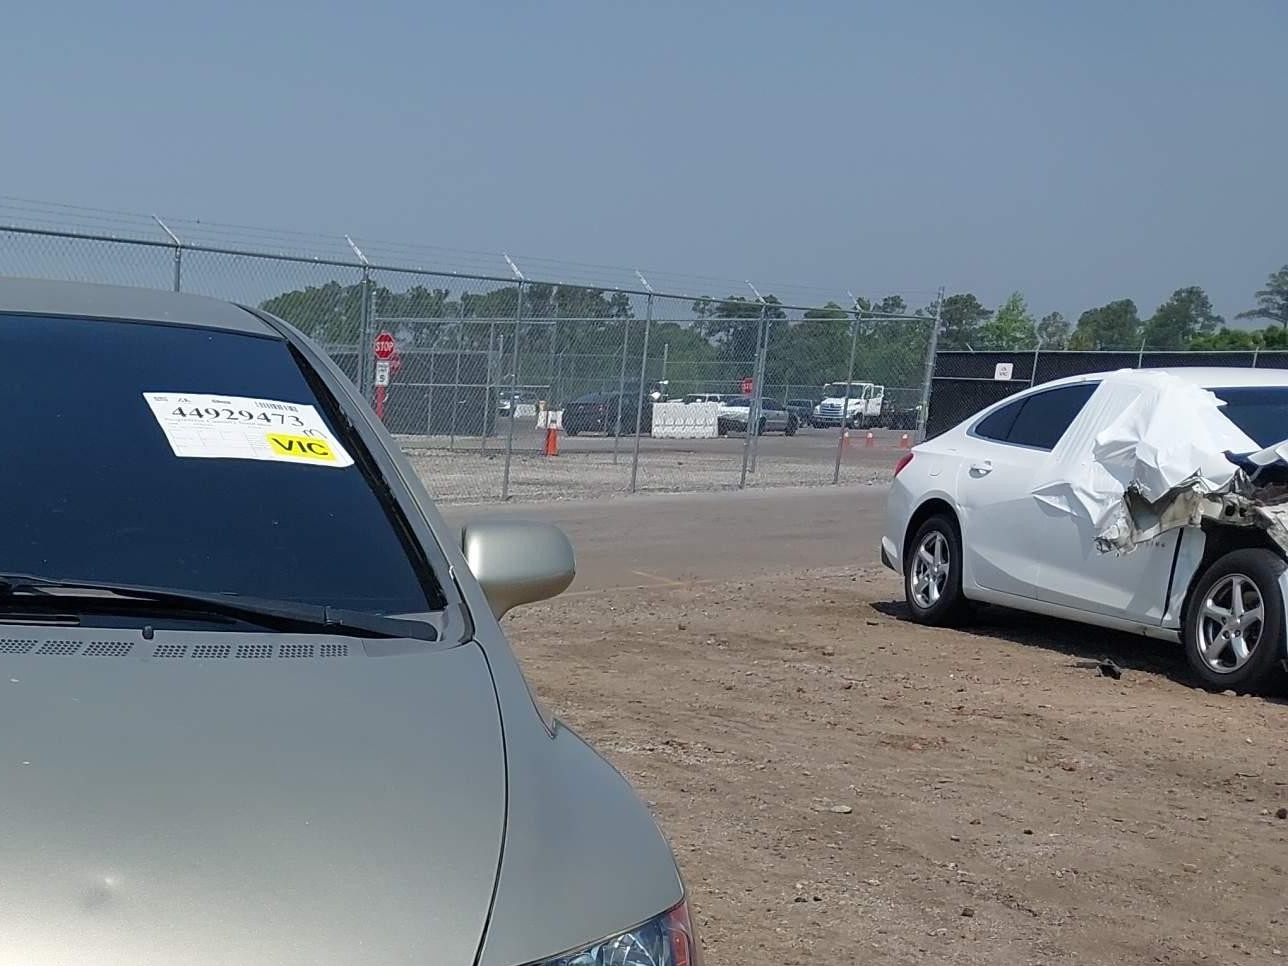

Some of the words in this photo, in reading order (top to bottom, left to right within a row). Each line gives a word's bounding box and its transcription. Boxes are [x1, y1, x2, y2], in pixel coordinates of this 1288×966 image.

[375, 341, 394, 352] STOP
[172, 406, 305, 427] 44929473
[272, 437, 329, 456] VIC
